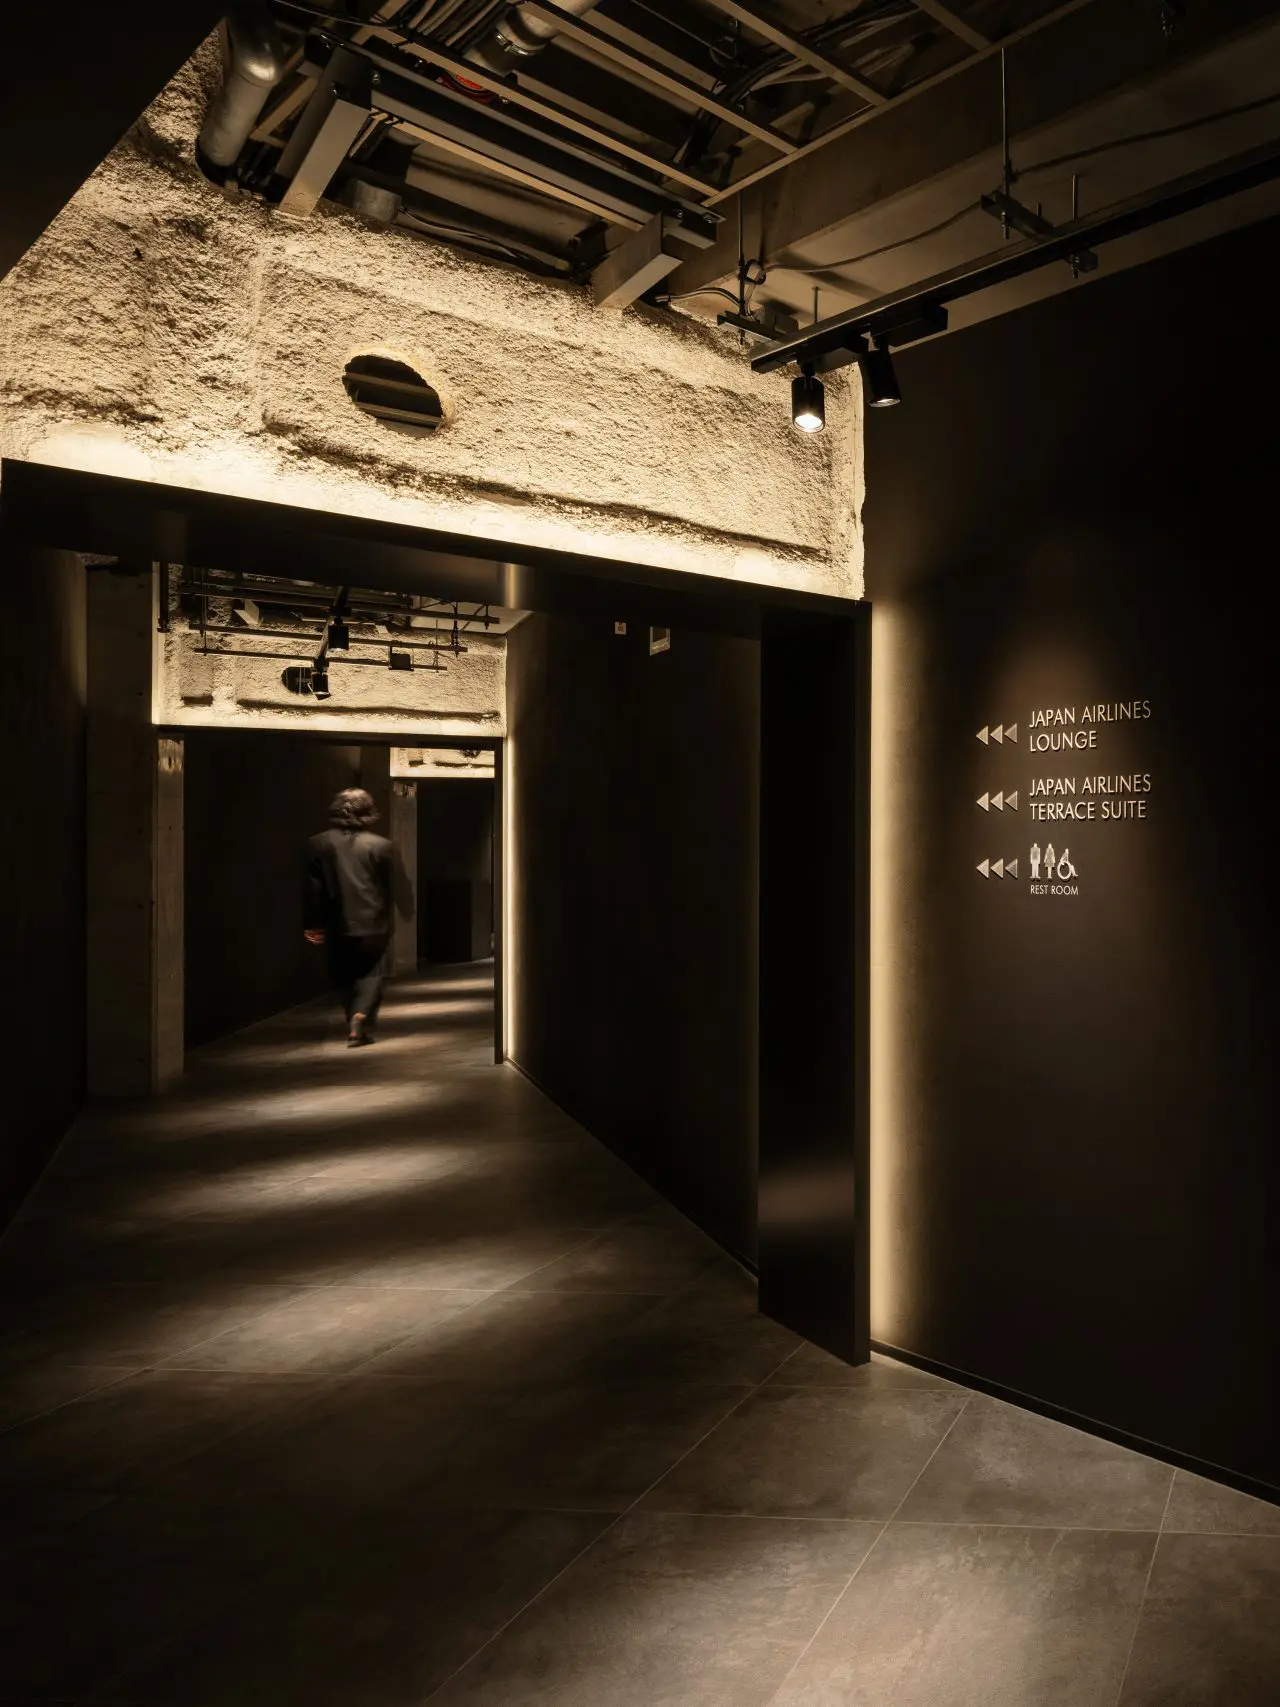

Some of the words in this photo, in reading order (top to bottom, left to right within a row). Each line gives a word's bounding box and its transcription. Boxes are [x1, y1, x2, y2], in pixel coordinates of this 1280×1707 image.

[1029, 707, 1075, 728] JAPAN
[1081, 700, 1151, 724] AIRLINES
[1029, 731, 1098, 752] LOUNGE
[1029, 777, 1076, 797] JAPAN
[1082, 774, 1151, 795] AIRLINES
[1029, 802, 1095, 820] TERRACE
[1101, 800, 1147, 820] SUITE
[1030, 885, 1048, 895] REST
[1051, 885, 1079, 895] ROOM
